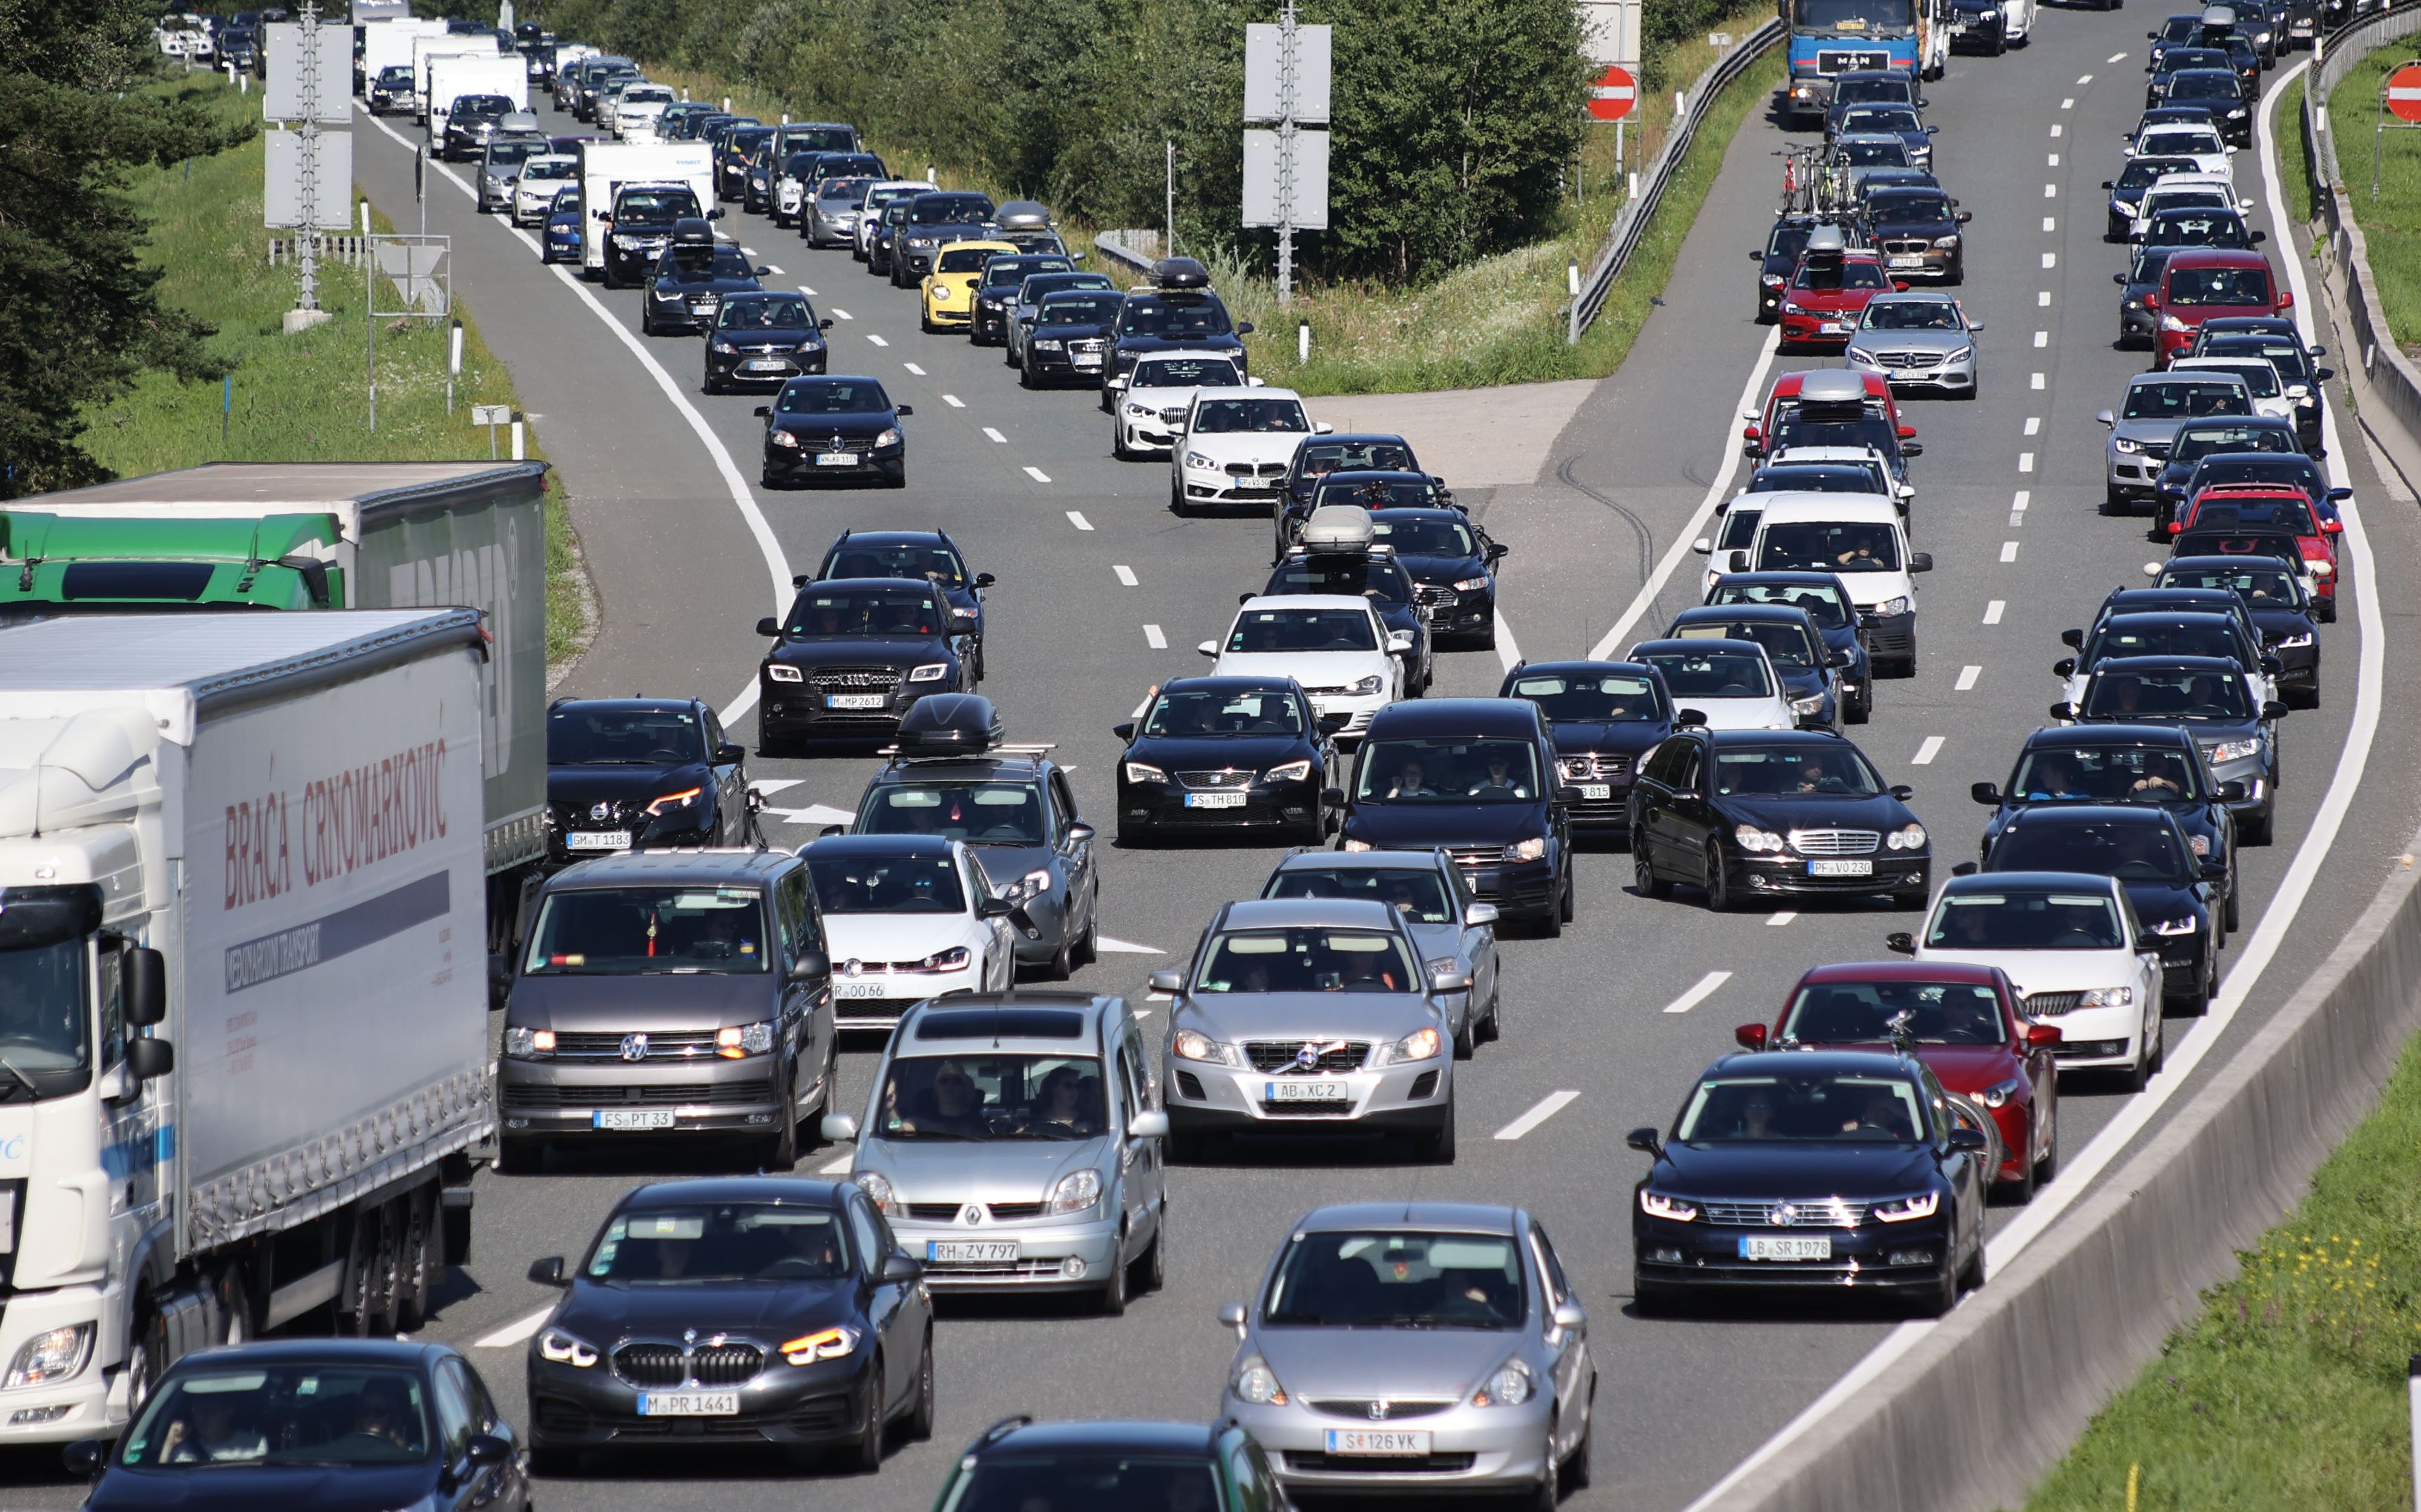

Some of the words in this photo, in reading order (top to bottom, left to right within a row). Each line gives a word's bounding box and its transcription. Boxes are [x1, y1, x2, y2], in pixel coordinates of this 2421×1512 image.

[1837, 56, 1870, 65] MAN
[833, 697, 839, 706] M
[845, 697, 858, 706] MP
[859, 697, 882, 706] 2612
[1589, 787, 1608, 797] 815
[1191, 795, 1204, 805] FS
[1212, 795, 1224, 805] TH
[1226, 795, 1245, 804] 810
[573, 835, 587, 845] GM
[594, 835, 601, 845] T
[604, 835, 629, 844] 1183
[1815, 863, 1828, 873] PF
[1851, 862, 1871, 873] 230
[278, 922, 320, 975] TRANSPORT
[869, 985, 883, 998] 66
[1280, 1085, 1298, 1097] AB
[1307, 1085, 1324, 1097] XC
[1329, 1084, 1336, 1097] 2
[605, 1113, 622, 1126] FS
[631, 1113, 648, 1126] PT
[652, 1113, 668, 1125] 33
[936, 1245, 956, 1259] RH
[965, 1244, 985, 1259] ZY
[988, 1244, 1016, 1258] 797
[1748, 1241, 1764, 1255] LB
[1775, 1241, 1792, 1255] SR
[1796, 1241, 1828, 1255] 1978
[647, 1398, 658, 1412] M
[670, 1397, 690, 1412] PR
[694, 1396, 735, 1412] 1441
[1345, 1435, 1355, 1449] S
[1368, 1435, 1393, 1449] 126
[1398, 1435, 1416, 1449] VK
